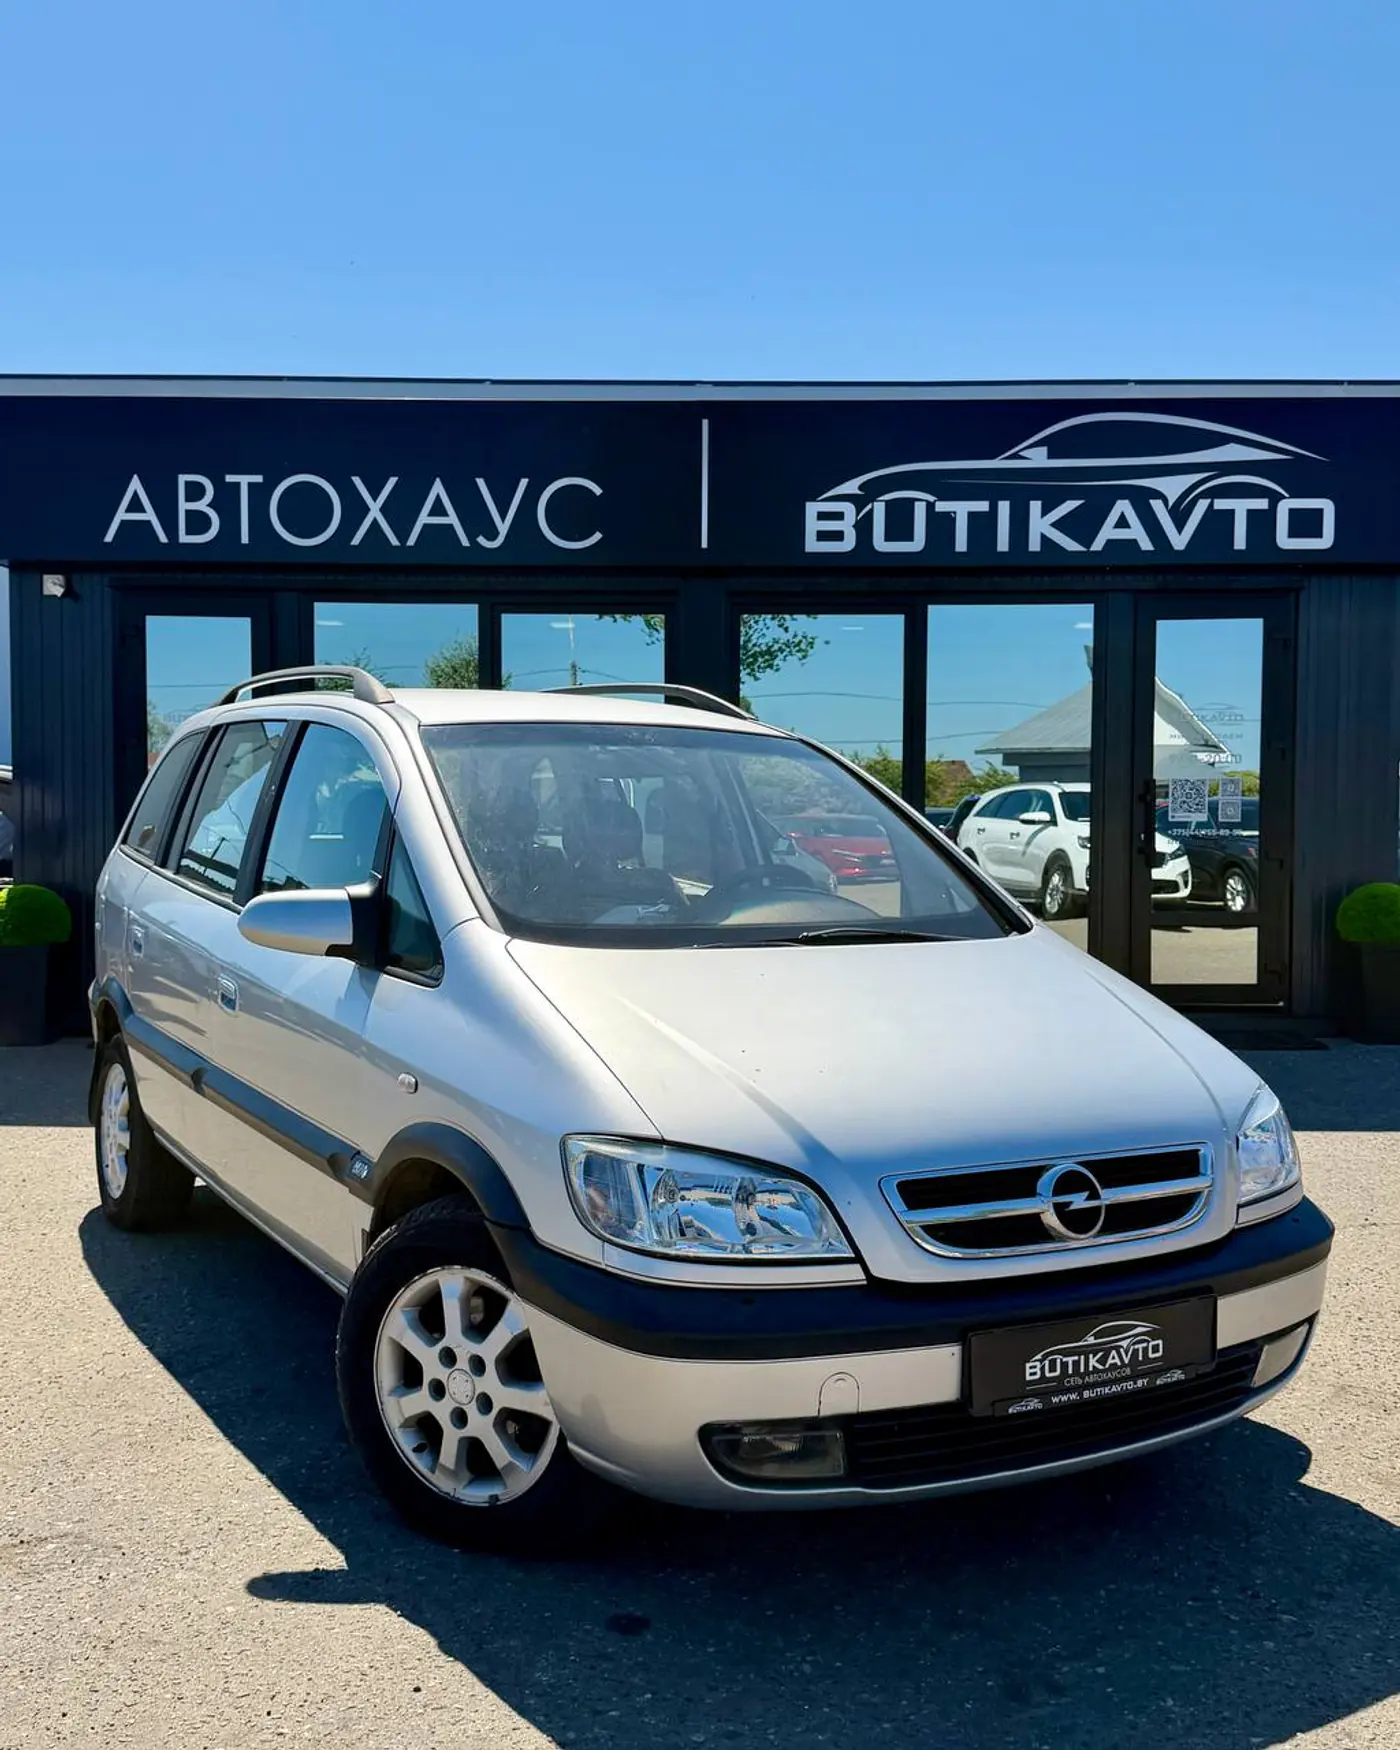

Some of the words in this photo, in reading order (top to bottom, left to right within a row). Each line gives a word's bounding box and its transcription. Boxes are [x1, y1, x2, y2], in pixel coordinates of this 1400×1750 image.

[104, 474, 603, 550] АВТОХАУС
[805, 498, 1336, 554] BUTIKAVTO
[1025, 1339, 1164, 1381] BUTIKAVTO
[1064, 1376, 1083, 1387] СЕТЬ
[1084, 1367, 1132, 1384] АВТОХАУСОВ
[1051, 1391, 1080, 1404] WWW.
[1083, 1378, 1150, 1399] BUTIKAVTO.BY
